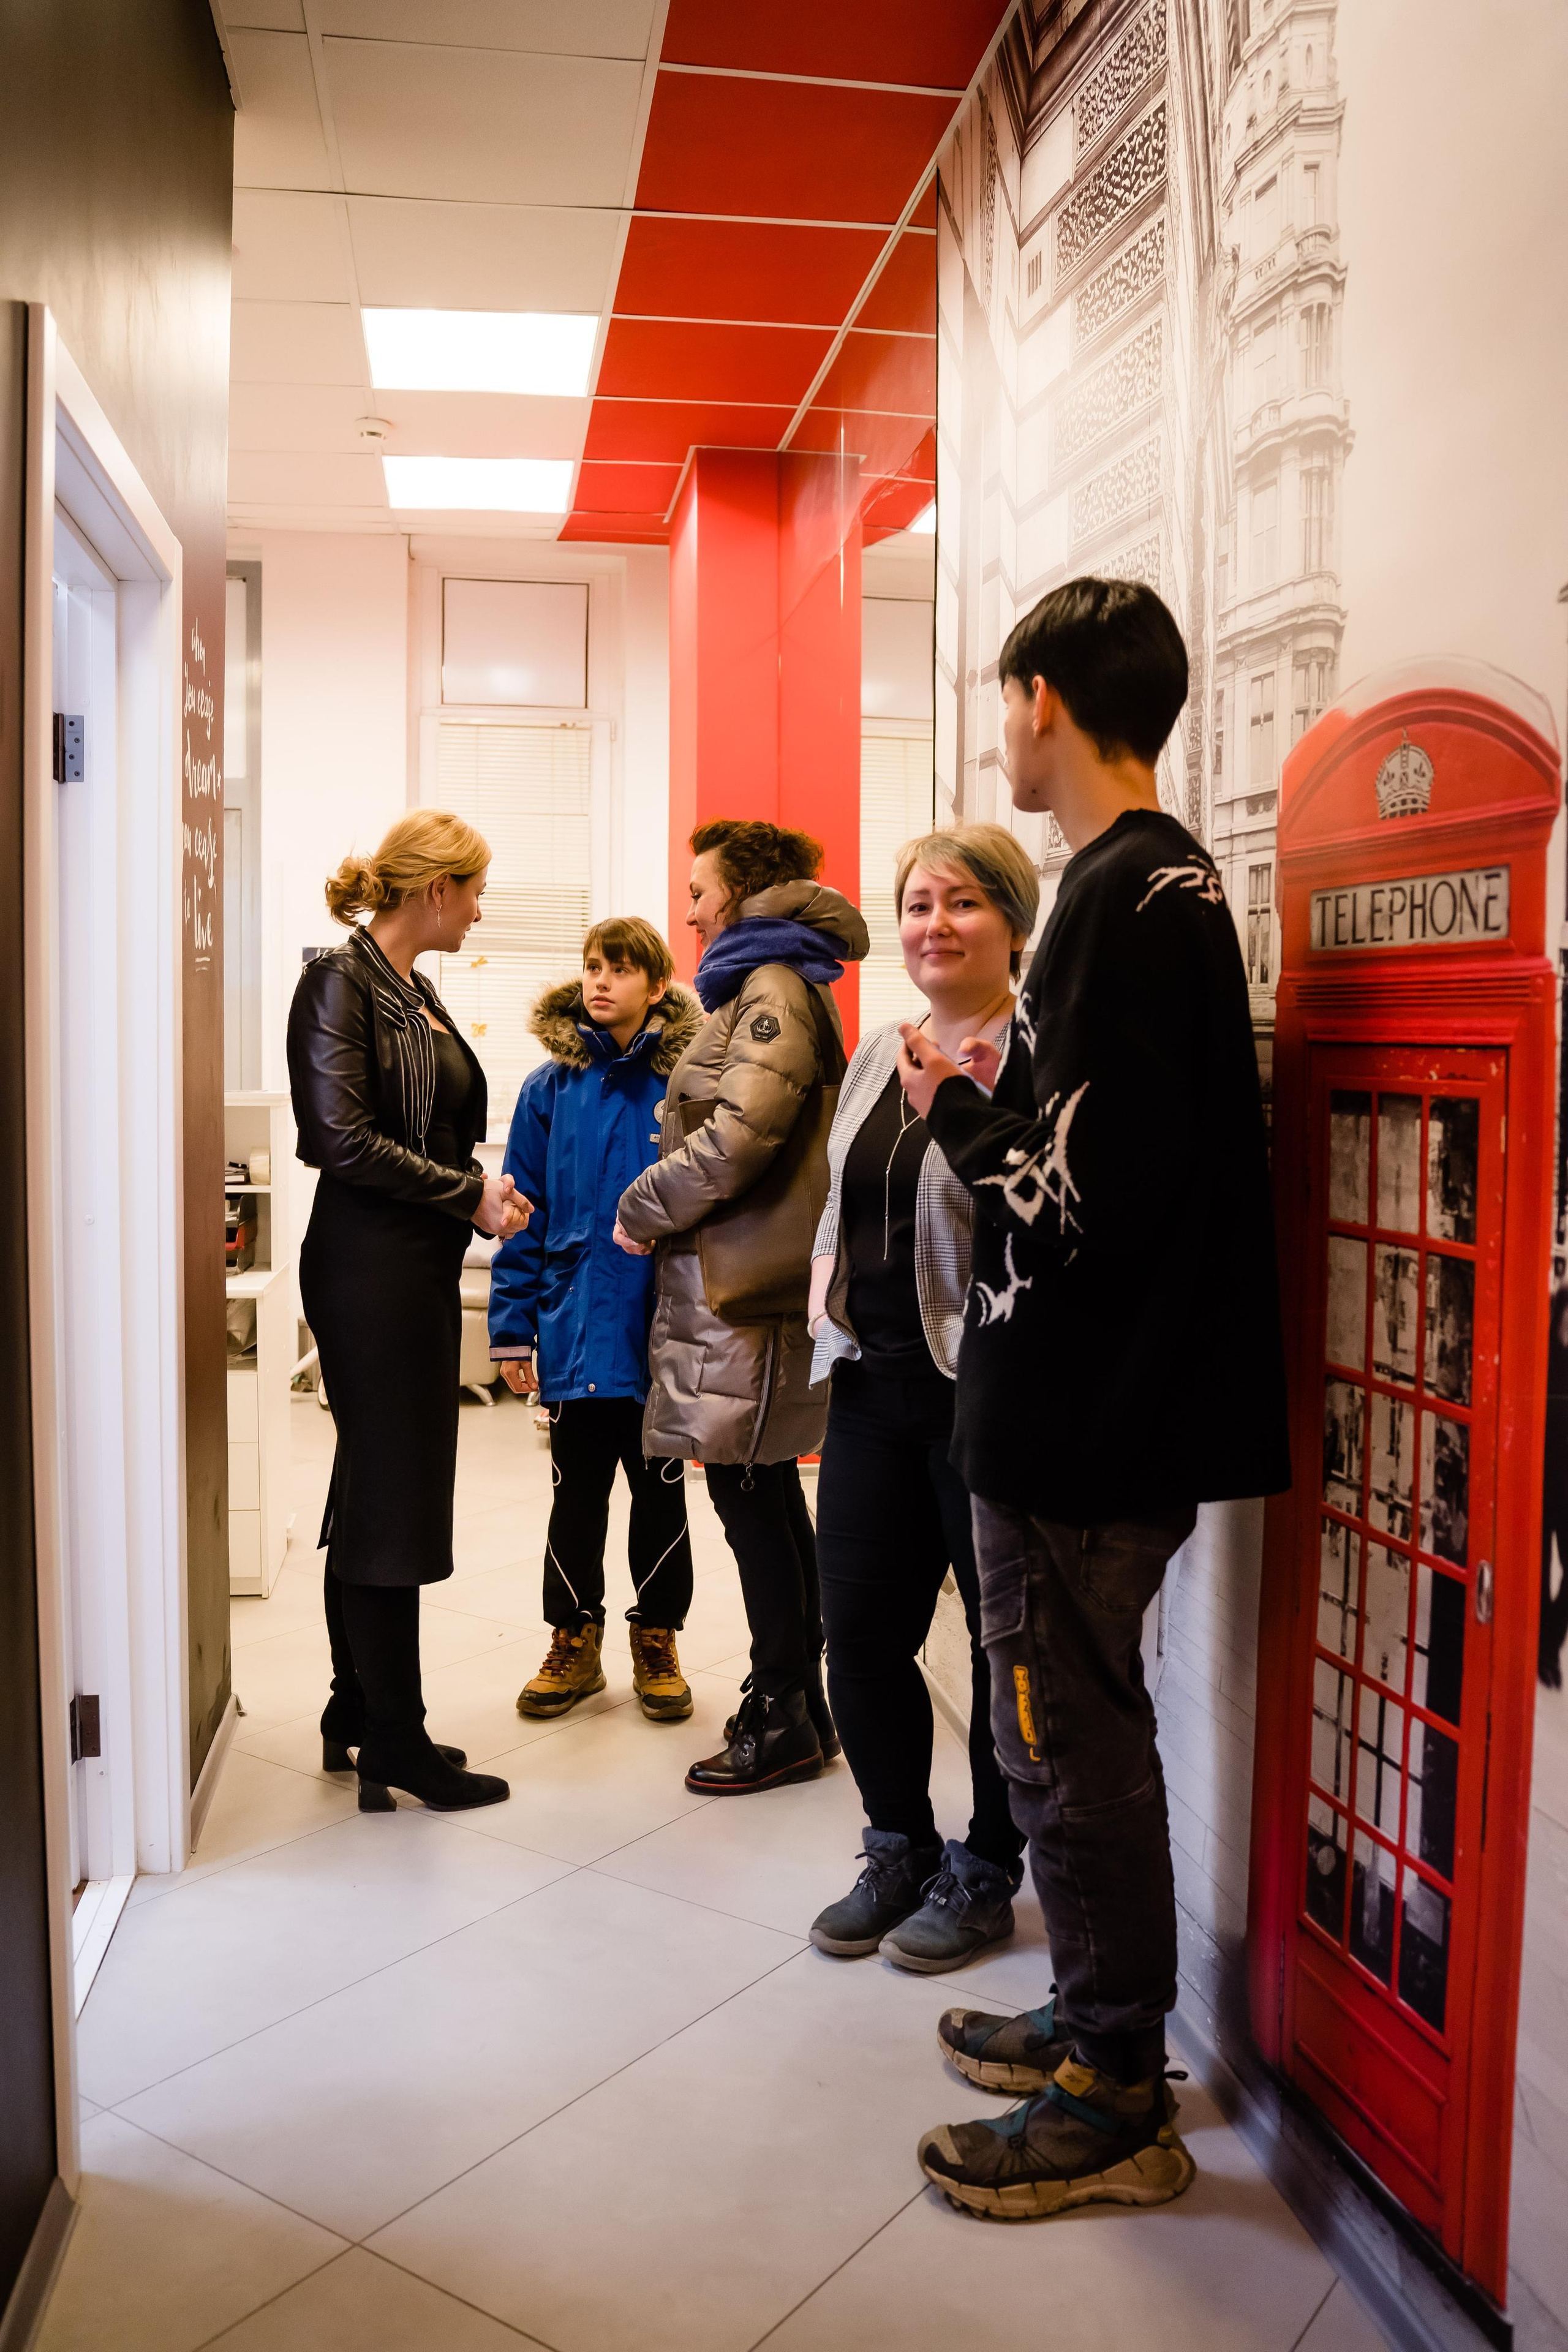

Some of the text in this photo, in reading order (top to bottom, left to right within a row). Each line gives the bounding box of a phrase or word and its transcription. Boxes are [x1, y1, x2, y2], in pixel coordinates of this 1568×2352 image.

[185, 729, 216, 801] dream
[195, 817, 217, 889] cease
[194, 874, 213, 950] live
[1316, 873, 1501, 947] TELEPHONE
